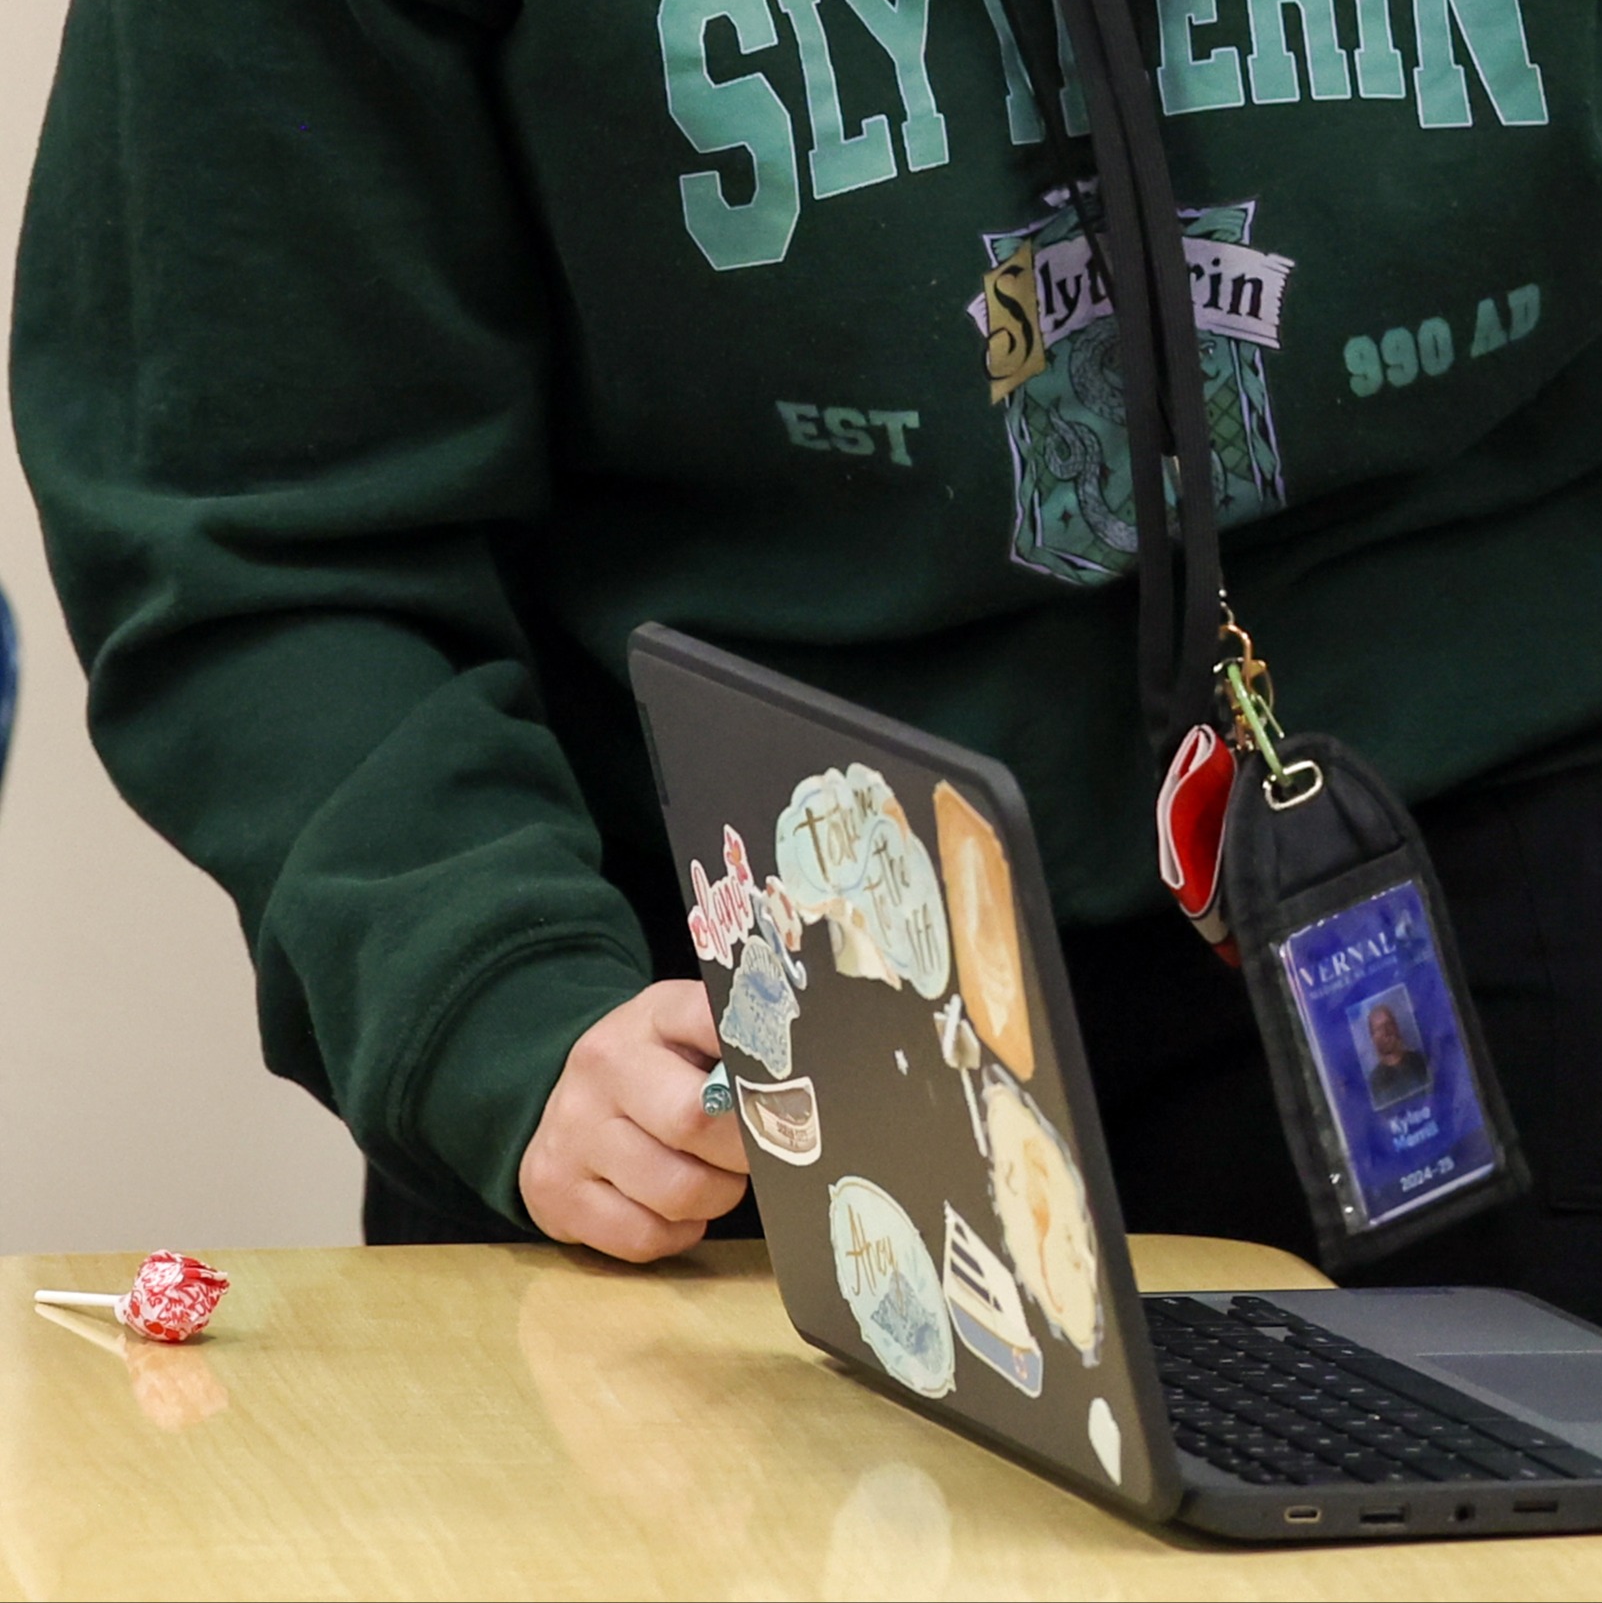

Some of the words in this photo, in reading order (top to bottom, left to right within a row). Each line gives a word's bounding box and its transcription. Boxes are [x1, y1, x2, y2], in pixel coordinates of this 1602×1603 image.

[1343, 316, 1455, 398] 990
[1469, 283, 1541, 359] AD
[774, 400, 921, 468] EST
[1299, 931, 1397, 987] VERNAL
